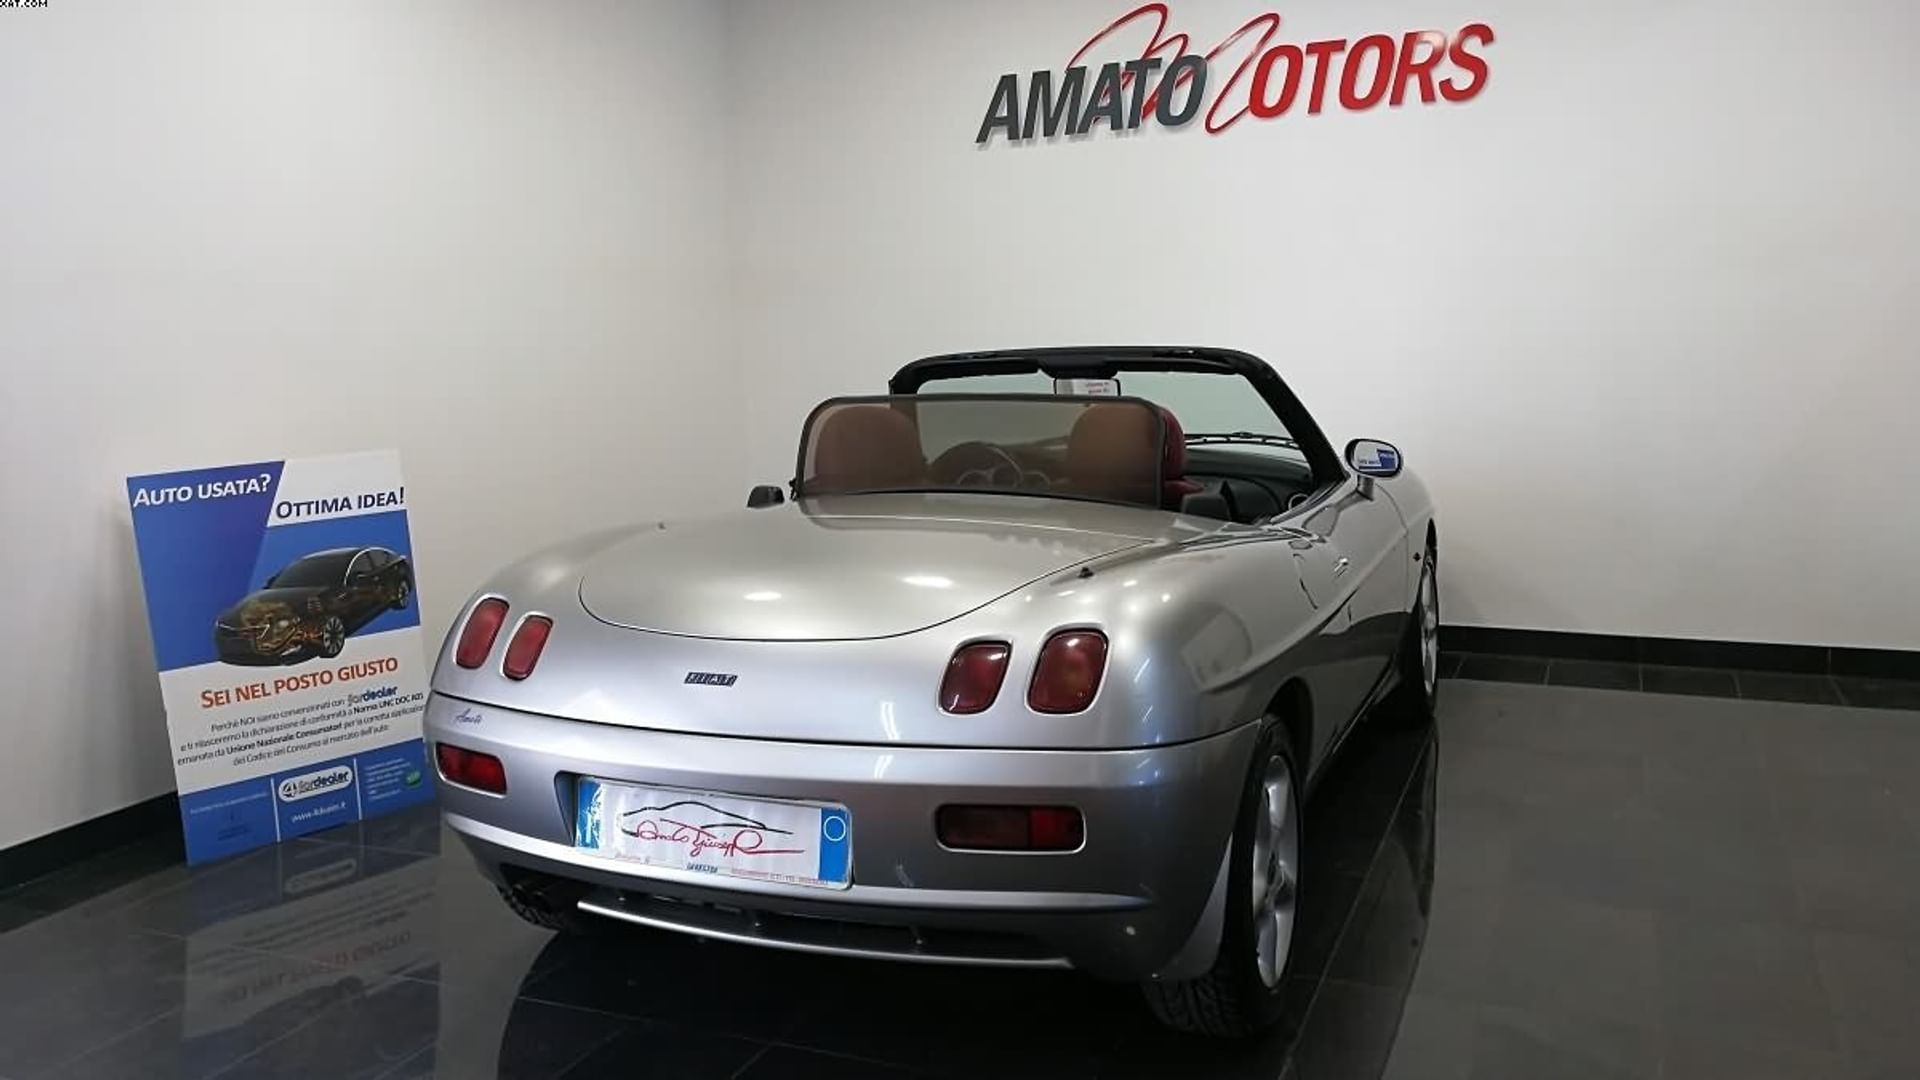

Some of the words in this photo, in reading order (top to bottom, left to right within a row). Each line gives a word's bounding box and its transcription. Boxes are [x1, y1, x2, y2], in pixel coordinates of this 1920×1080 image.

[976, 55, 1208, 143] AMATO
[133, 486, 193, 507] AUTO
[198, 473, 272, 499] USATA?
[276, 494, 351, 518] OTTIMA
[357, 486, 405, 510] IDEA!
[201, 688, 231, 709] SEI
[235, 683, 271, 702] NEL
[275, 670, 333, 694] POSTO
[337, 657, 398, 681] GIUSTO
[683, 670, 739, 688] FIAT
[353, 703, 379, 714] Norma
[226, 742, 256, 755] Unione
[256, 733, 294, 748] Nazionale
